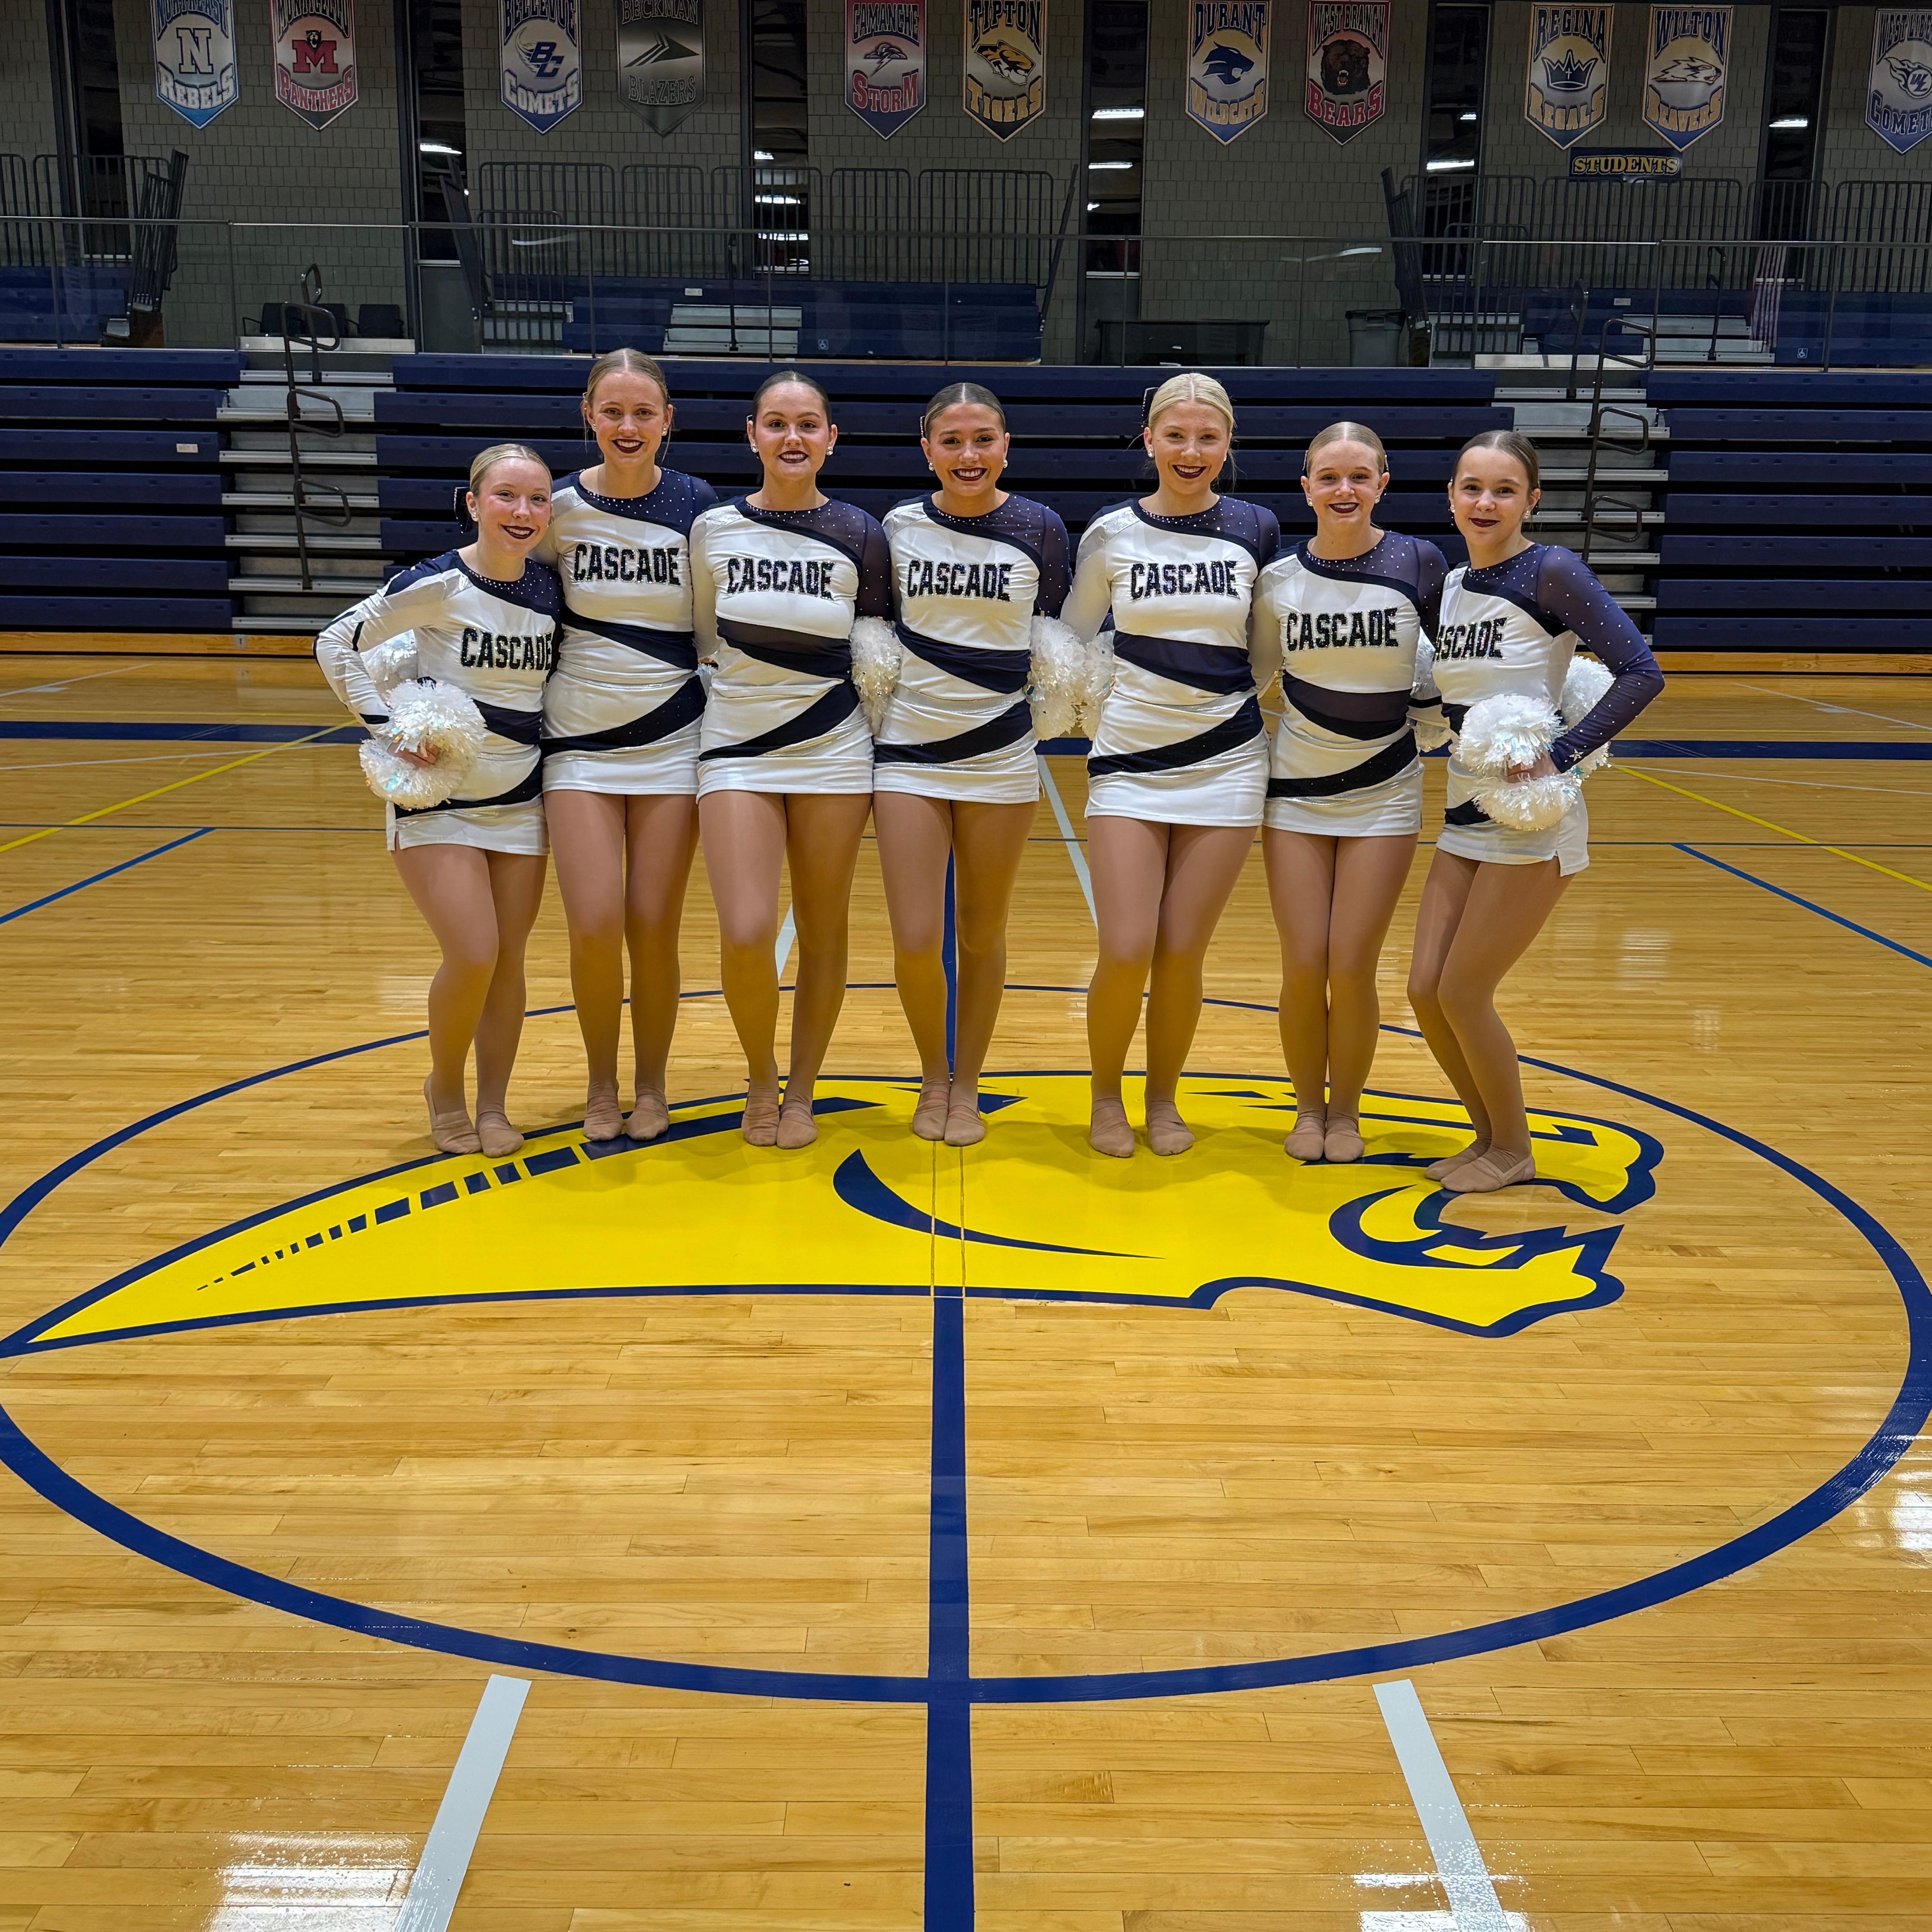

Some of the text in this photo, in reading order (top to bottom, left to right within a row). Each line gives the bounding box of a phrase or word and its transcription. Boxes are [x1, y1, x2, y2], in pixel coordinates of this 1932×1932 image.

[622, 0, 698, 25] BECKMAN
[852, 3, 919, 45] CAMANCHE
[969, 0, 1041, 53] TIPTON
[1193, 2, 1265, 55] DURANT
[1313, 4, 1386, 59] WEST BRANCH
[176, 28, 214, 74] N
[292, 39, 339, 74] M
[1534, 9, 1606, 63] REGINA
[1655, 9, 1726, 64] WILTON
[1877, 13, 1909, 64] WEST
[158, 63, 235, 110] REBELS
[278, 65, 354, 111] PANTHERS
[504, 70, 580, 115] COMETS
[629, 75, 696, 105] BLAZERS
[852, 69, 918, 113] STORM
[968, 76, 1041, 122] TIGERS
[1308, 80, 1383, 126] BEARS
[1870, 91, 1932, 134] COMET
[1573, 156, 1679, 174] STUDENTS
[573, 543, 681, 585] CASCADE
[727, 557, 836, 600] CASCADE
[907, 559, 1015, 603] CASCADE
[1130, 560, 1240, 601] CASCADE
[461, 627, 552, 671] CASCADE
[1286, 607, 1399, 651] CASCADE
